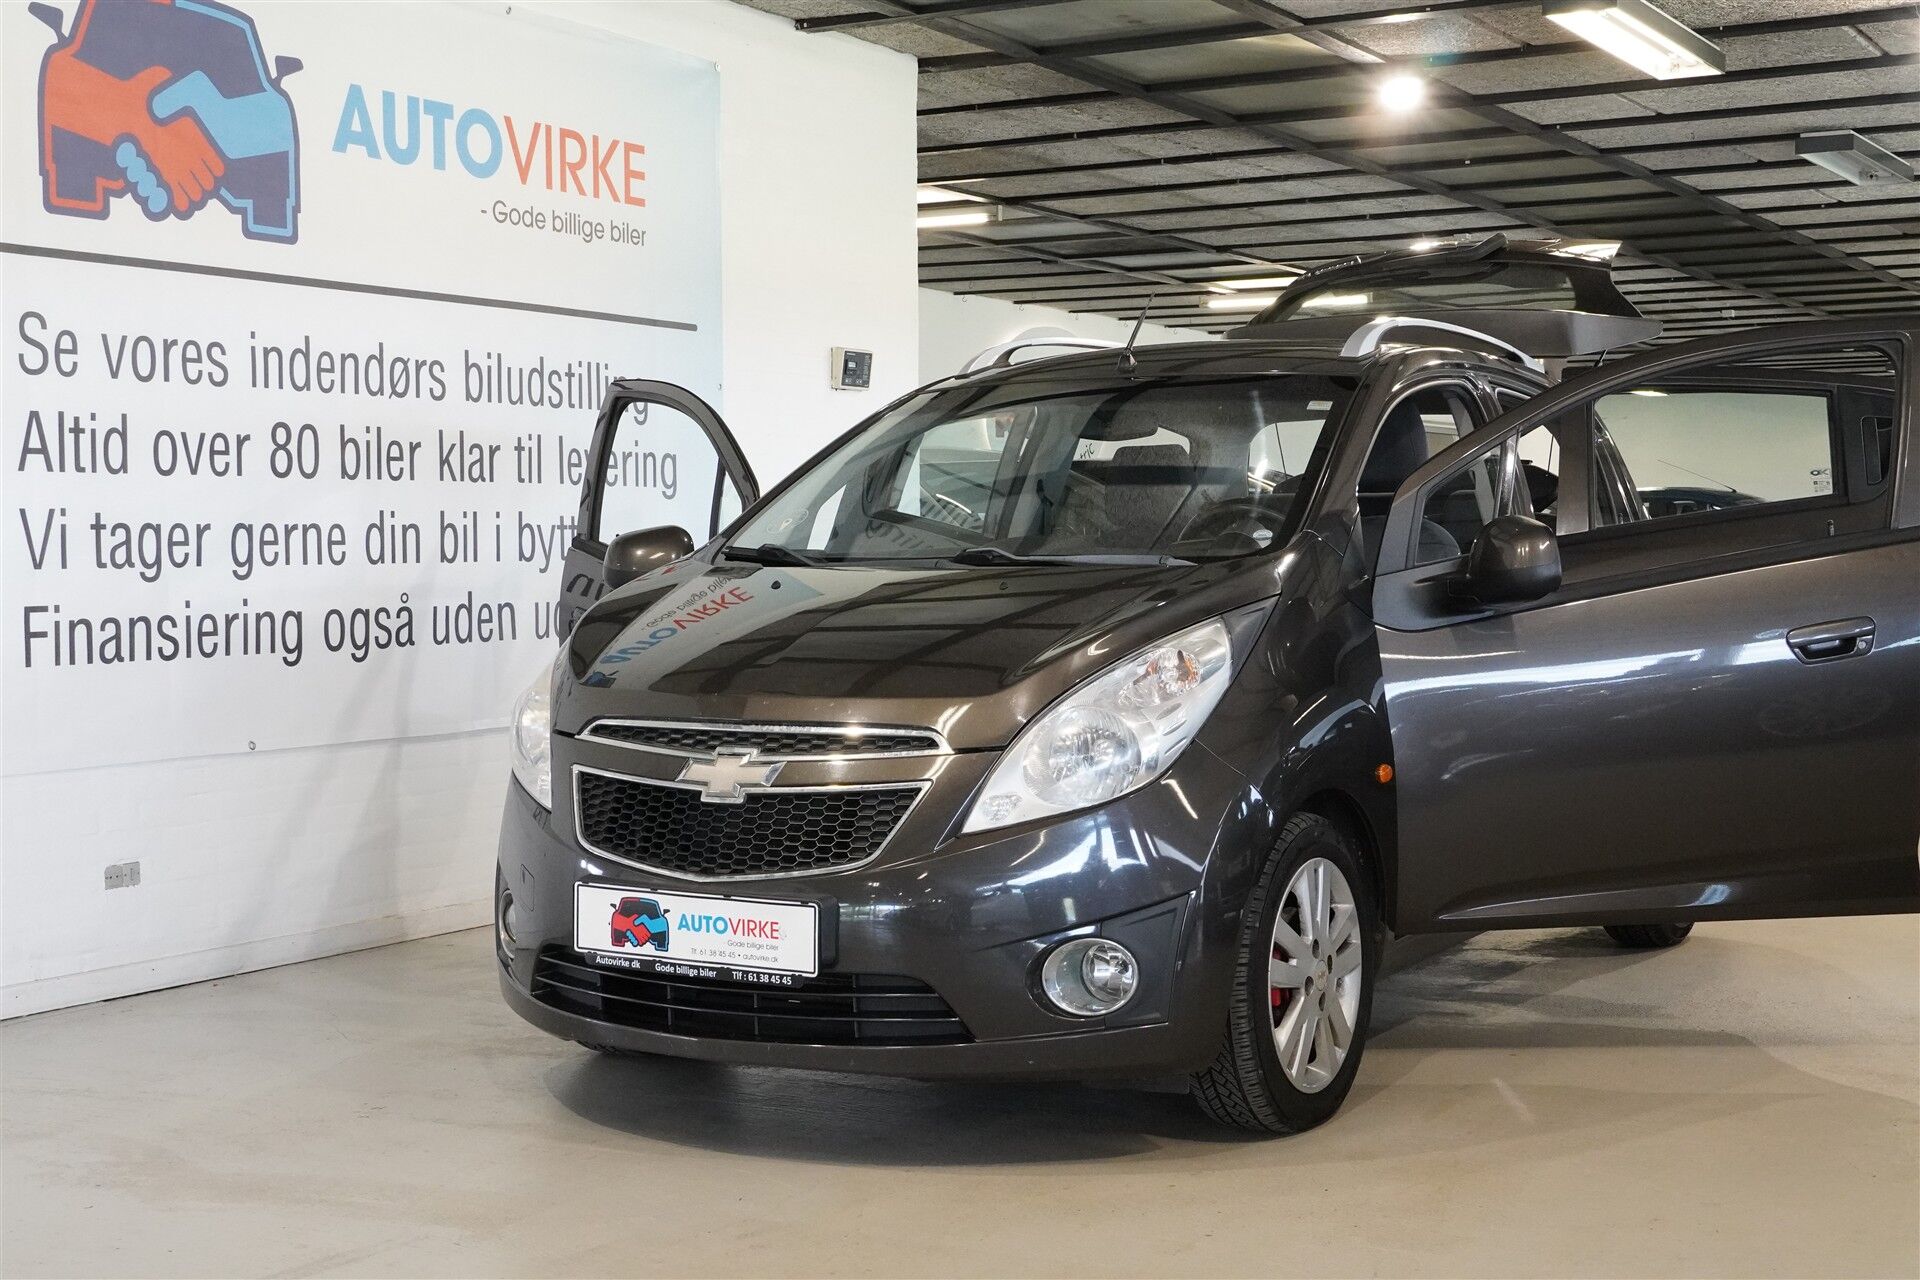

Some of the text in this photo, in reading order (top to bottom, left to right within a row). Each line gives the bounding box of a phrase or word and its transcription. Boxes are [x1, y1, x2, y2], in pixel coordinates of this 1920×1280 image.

[332, 83, 647, 208] AUTOVIRKE
[492, 199, 547, 231] Gode
[551, 209, 605, 244] billige
[610, 219, 647, 247] biler
[18, 311, 649, 426] Se vores indendørs biludstillig
[17, 410, 678, 500] Altid over 80 biler klar til leering
[18, 508, 68, 571] Vi
[90, 512, 213, 583] tager
[230, 521, 348, 581] gerne
[365, 509, 422, 565] din
[439, 510, 479, 564] bil
[494, 511, 502, 562] i
[23, 605, 304, 668] Finansiering
[323, 592, 416, 664] også
[432, 590, 518, 646] uden
[677, 913, 780, 940] AUTOVIRKE
[727, 939, 746, 949] Gode
[746, 942, 765, 952] billige
[595, 955, 630, 968] Autovirke
[631, 960, 641, 969] dk
[655, 963, 675, 973] Gode
[675, 965, 698, 977] billige
[699, 968, 717, 978] biler
[747, 973, 758, 982] 61
[759, 974, 769, 983] 38
[770, 975, 781, 984] 45
[781, 976, 792, 985] 45
